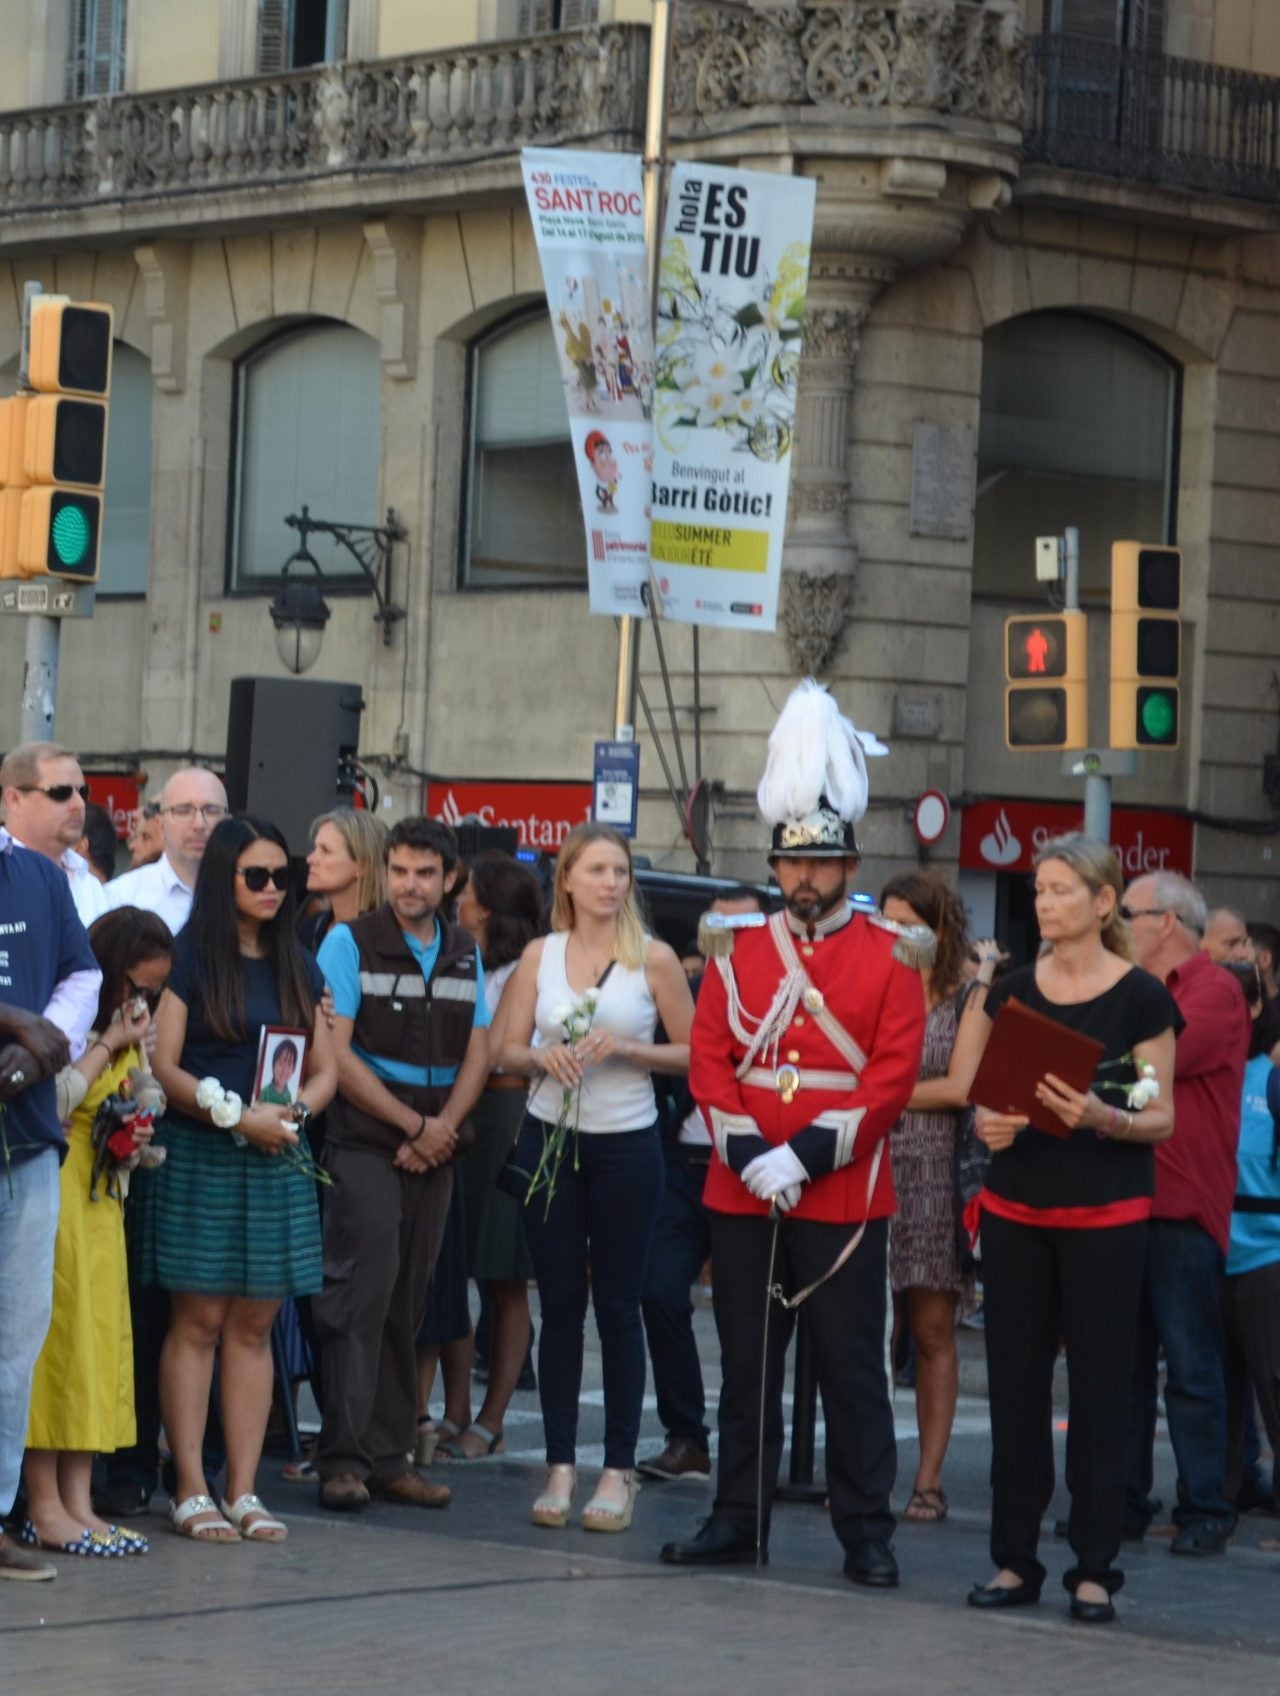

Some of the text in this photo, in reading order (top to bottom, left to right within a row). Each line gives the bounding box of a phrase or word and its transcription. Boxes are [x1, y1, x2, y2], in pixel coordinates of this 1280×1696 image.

[554, 173, 591, 187] FESTES
[535, 187, 642, 216] SANT ROC
[674, 179, 702, 234] hola
[704, 183, 748, 229] ES
[700, 230, 761, 278] TIU
[672, 461, 731, 485] Benvingut
[734, 468, 745, 483] al
[704, 486, 772, 517] Gòtic!
